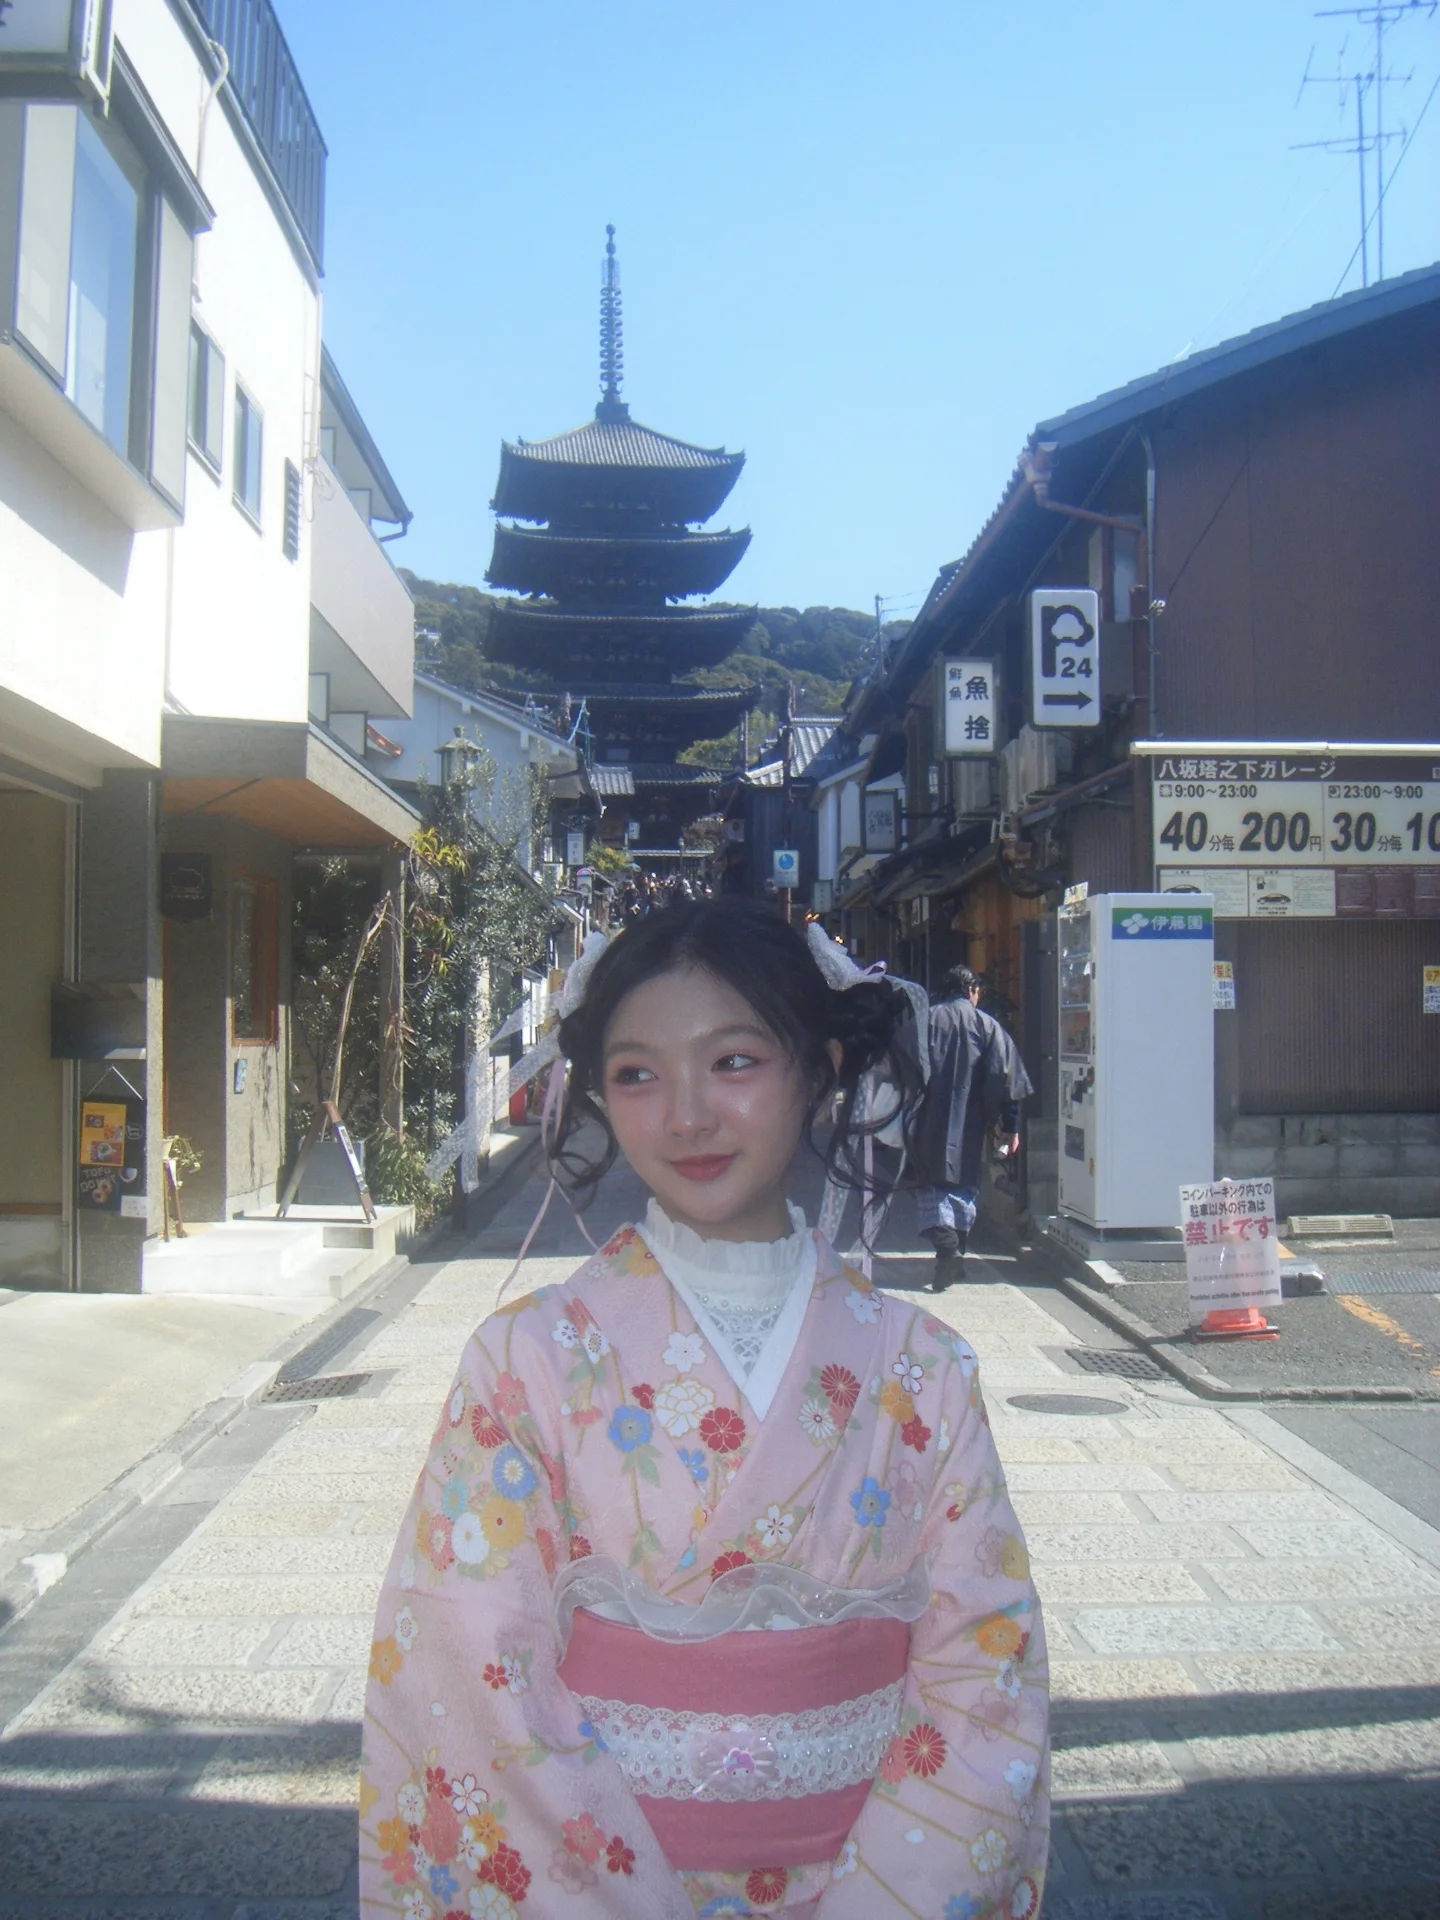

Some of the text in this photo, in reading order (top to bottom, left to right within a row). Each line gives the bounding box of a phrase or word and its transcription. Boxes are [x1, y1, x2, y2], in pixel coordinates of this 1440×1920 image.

[1061, 657, 1093, 678] 24
[949, 667, 962, 700] 鮮魚
[965, 676, 990, 740] 魚捨
[1159, 760, 1336, 779] 八坂塔之下ガレージ
[1239, 811, 1322, 852] 200円
[1151, 915, 1203, 930] 伊藤園
[1182, 1183, 1272, 1201] コインパーキング内での
[1190, 1200, 1265, 1217] 駐車以外の行為は
[1185, 1216, 1274, 1246] 禁止です
